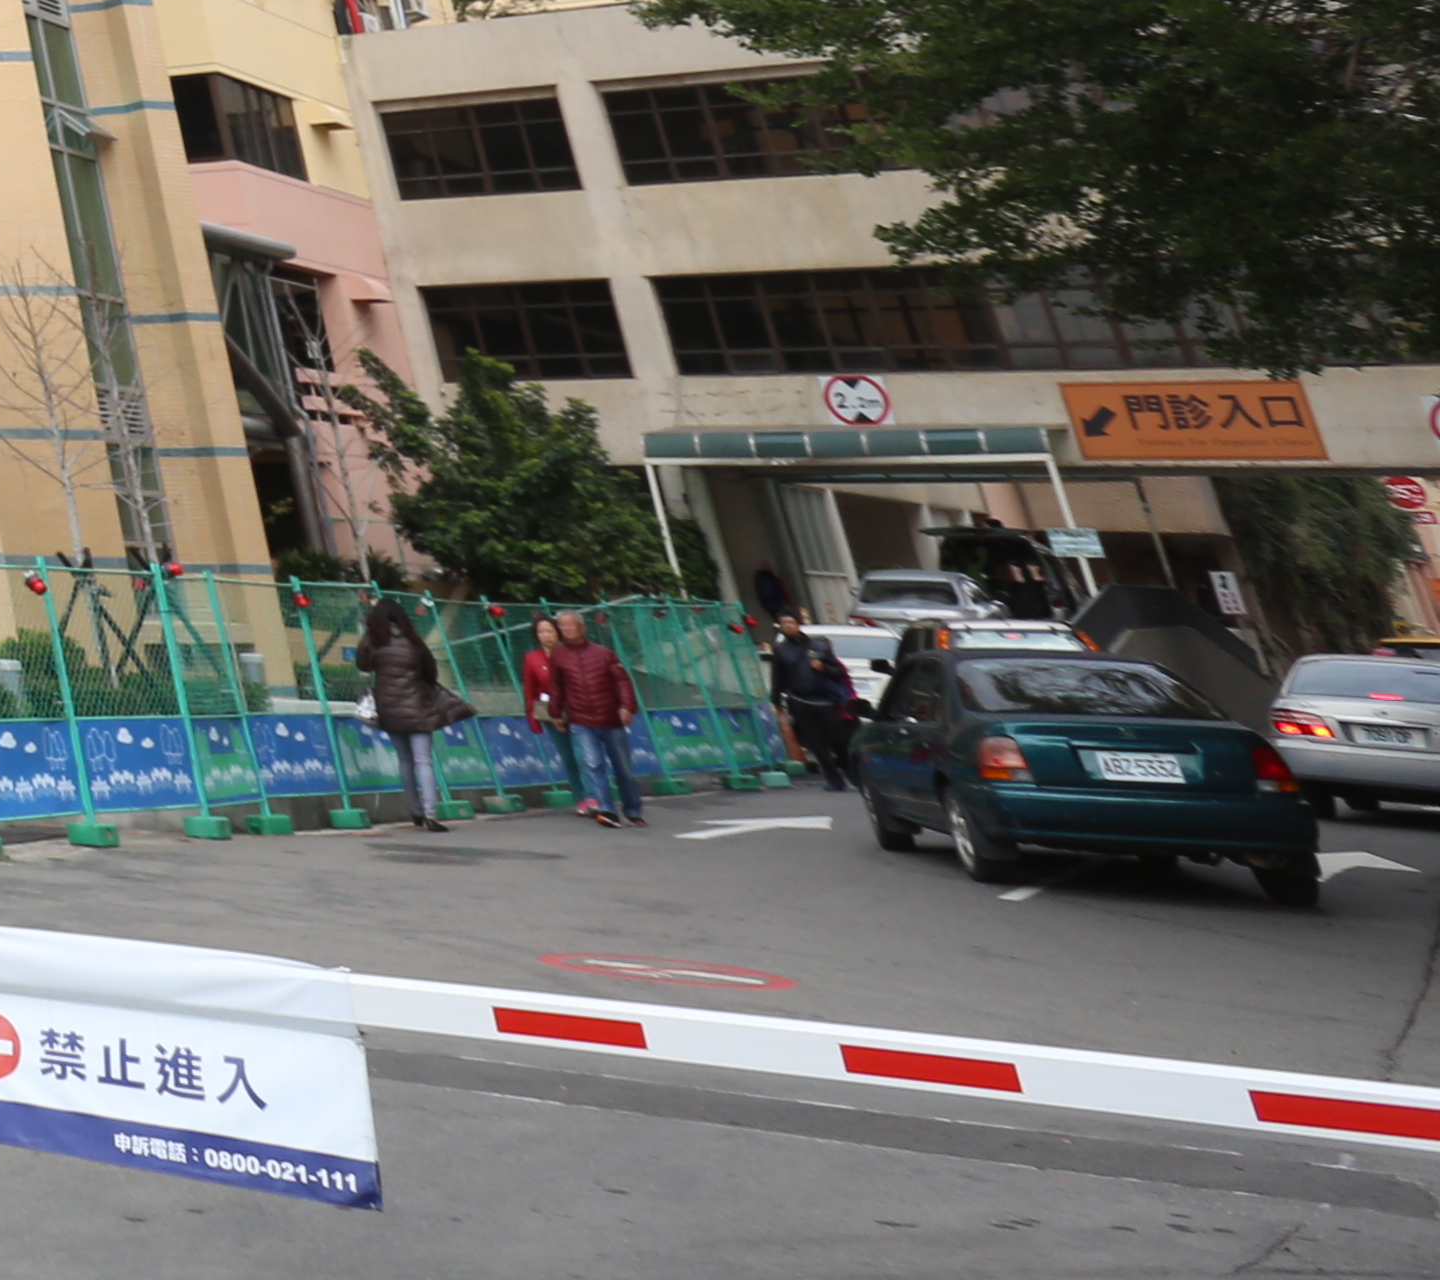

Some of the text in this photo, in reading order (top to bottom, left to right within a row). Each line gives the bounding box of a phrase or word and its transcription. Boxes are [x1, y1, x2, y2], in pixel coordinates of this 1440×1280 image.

[1122, 394, 1305, 430] 門診入口
[39, 1028, 268, 1111] 禁止進入
